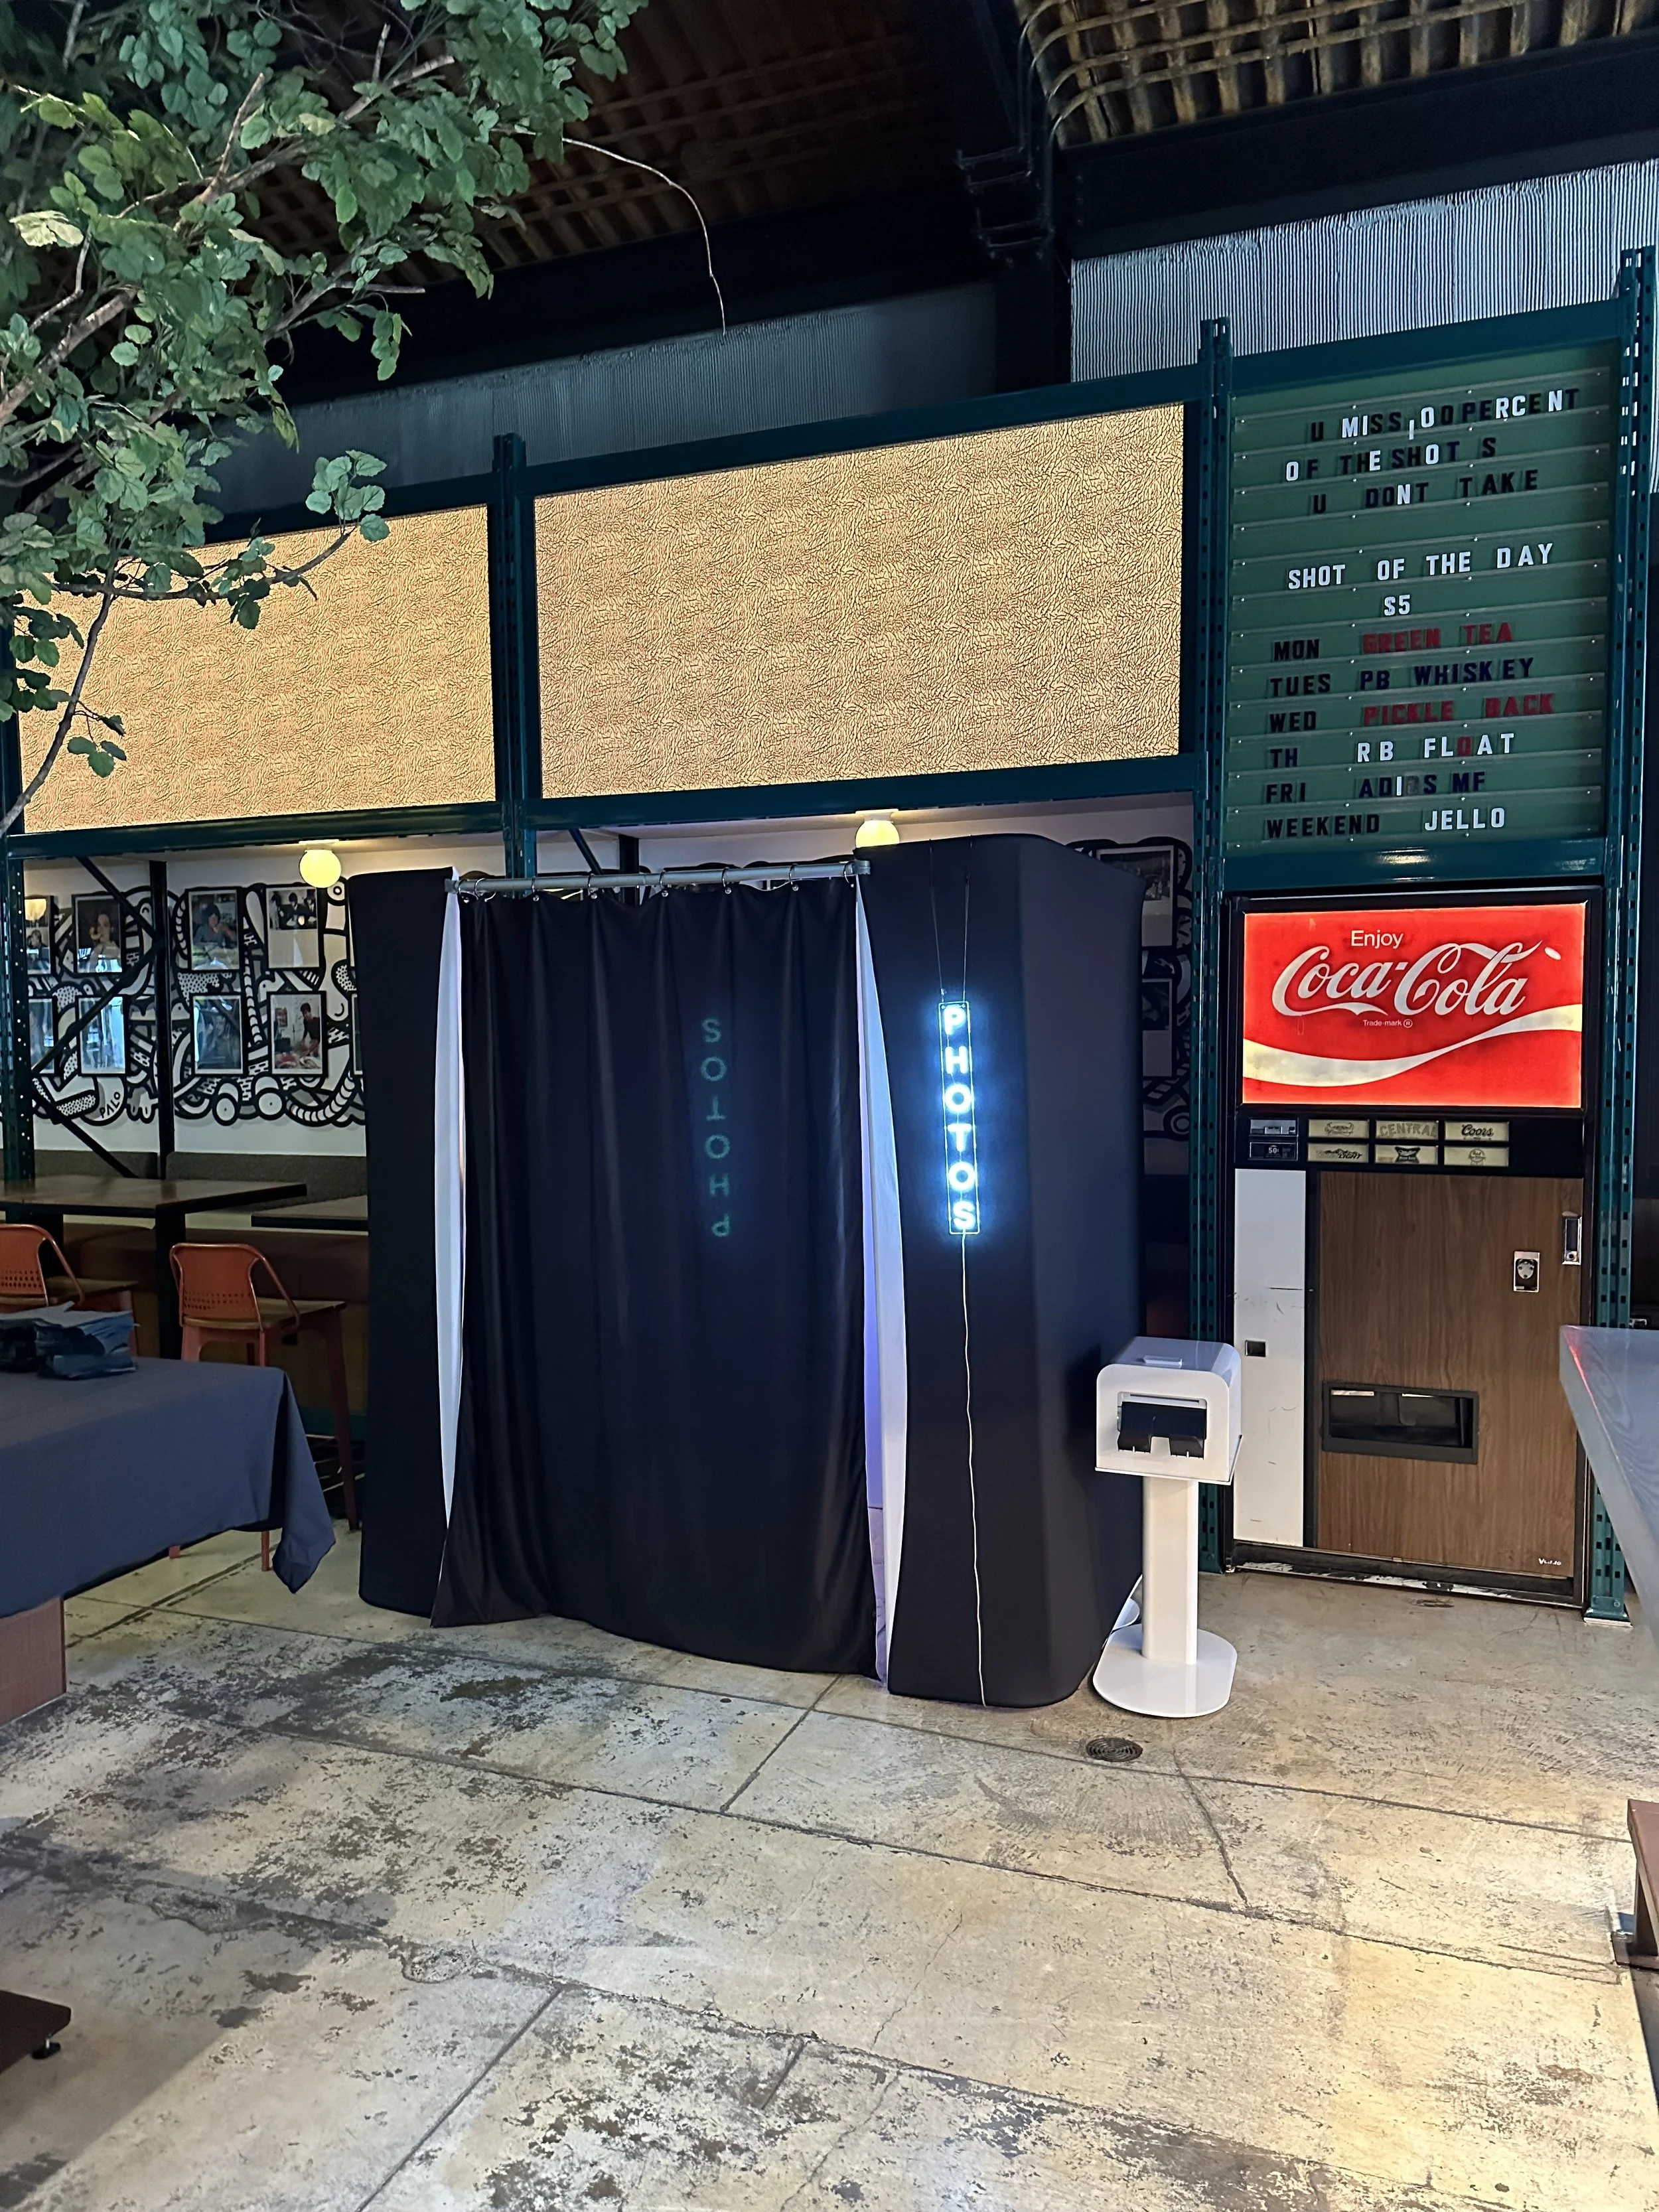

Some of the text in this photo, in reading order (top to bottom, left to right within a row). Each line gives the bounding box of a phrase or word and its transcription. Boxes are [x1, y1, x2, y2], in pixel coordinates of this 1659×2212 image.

[1342, 412, 1402, 439] MISS
[1285, 459, 1319, 482] OF
[1339, 450, 1382, 475] THE
[1313, 469, 1538, 514] U DONT TAKE
[1288, 542, 1553, 589] SHOT OF THE DAY
[1384, 594, 1411, 616] $5
[1273, 623, 1514, 661] MON GREEN TEA
[1270, 657, 1534, 696] TUES PB WHISKEY
[1269, 693, 1555, 733] WED PICKLE BACK
[1270, 733, 1515, 768] TH RB FLOAT
[1266, 782, 1306, 803] FRI
[1452, 772, 1486, 793] MF
[1267, 807, 1506, 839] WEEKEND JELLO
[1350, 929, 1404, 948] Enjoy
[1271, 940, 1543, 1017] Coca-Cola
[943, 1006, 975, 1230] PHOTOS
[1379, 1123, 1437, 1138] CENTRAL
[1461, 1124, 1494, 1137] Coors
